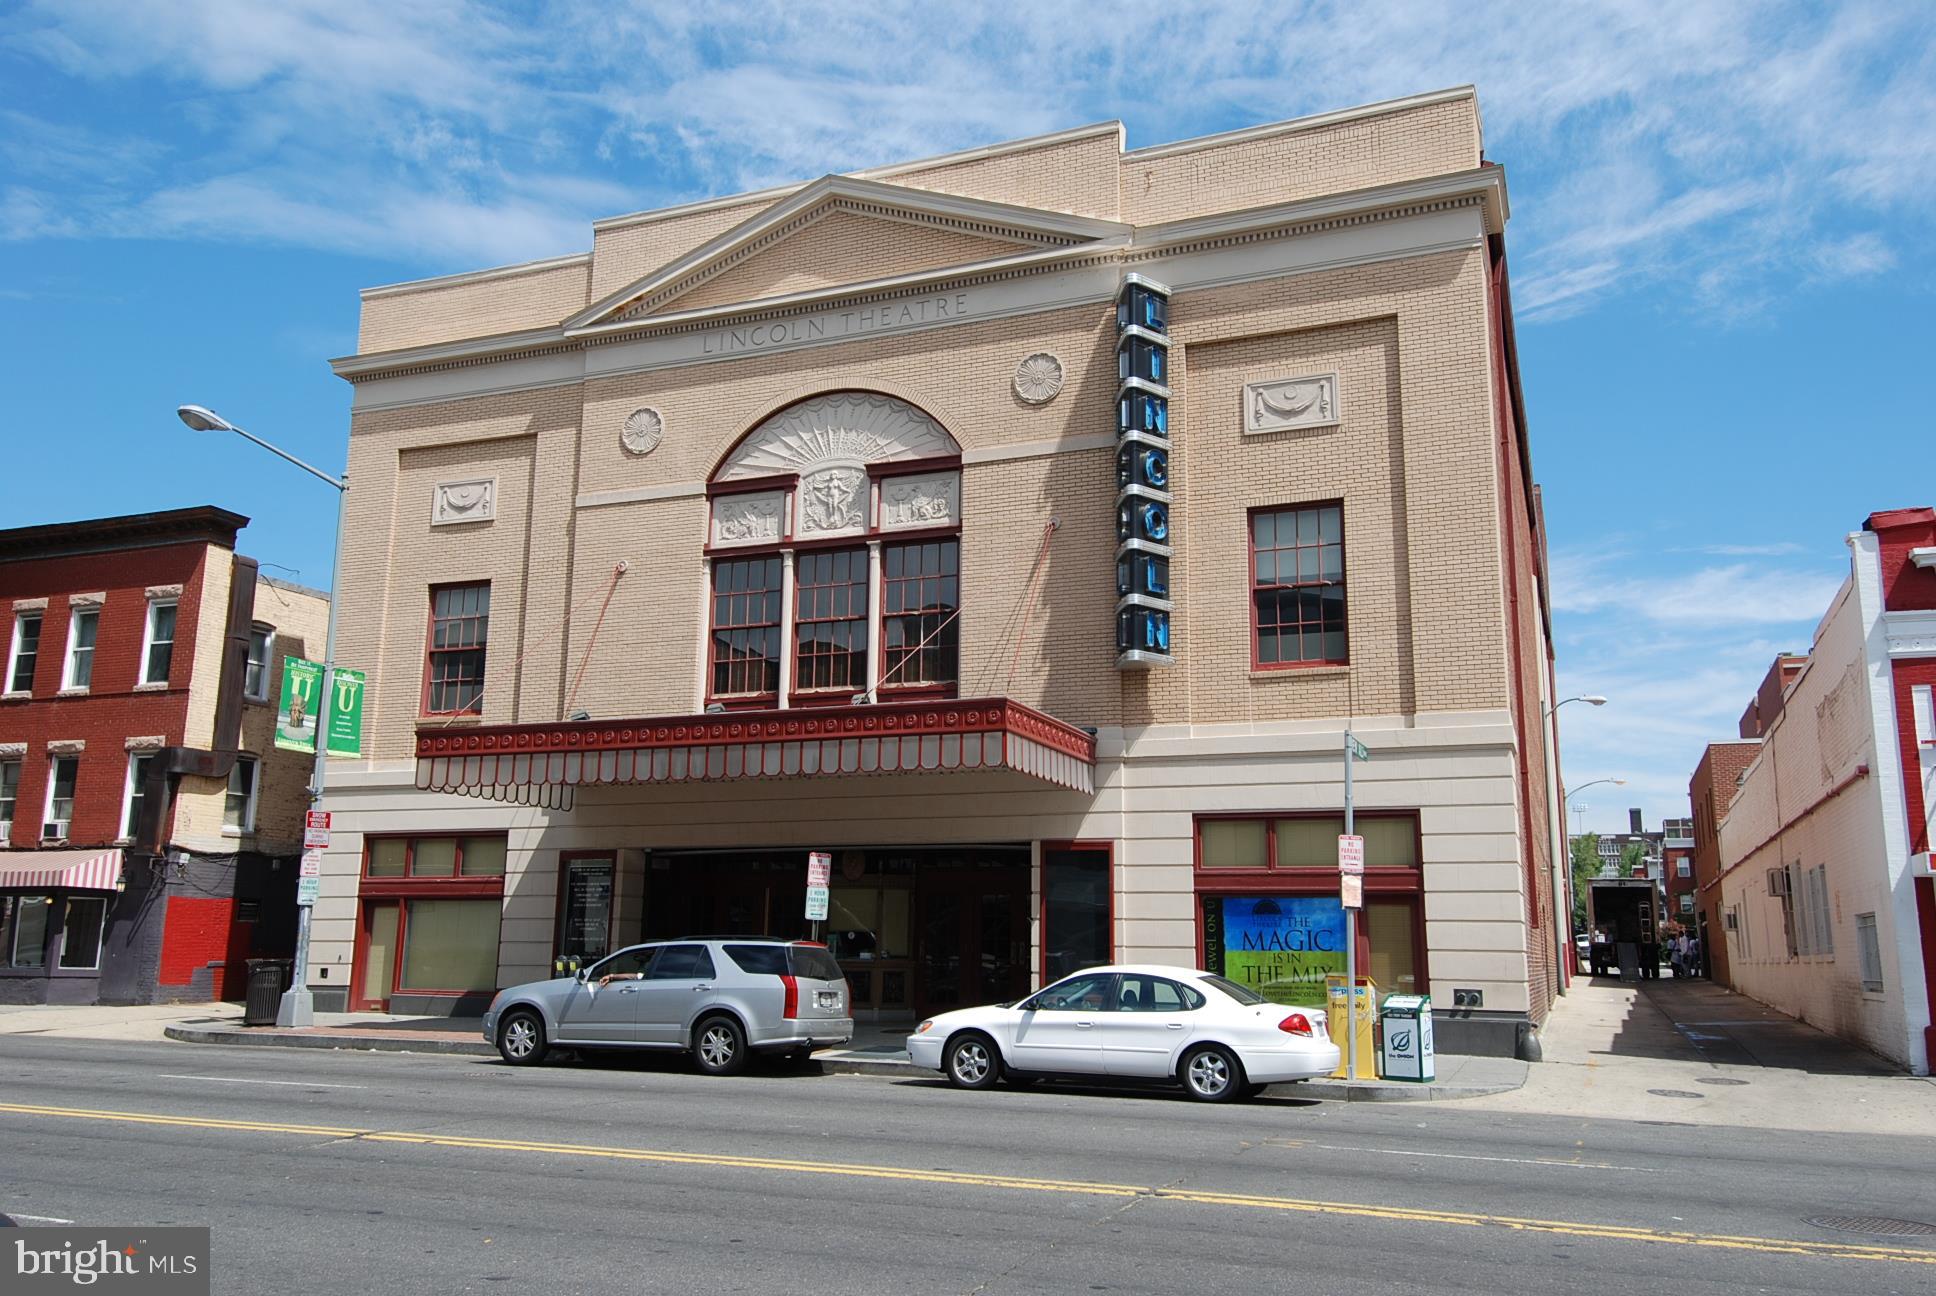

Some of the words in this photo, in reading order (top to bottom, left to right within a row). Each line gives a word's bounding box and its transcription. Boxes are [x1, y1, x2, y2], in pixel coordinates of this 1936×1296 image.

[703, 317, 825, 354] LINCOLN
[841, 294, 968, 332] THEATRE
[1144, 293, 1169, 650] LINCOLN
[338, 686, 357, 712] U
[1287, 917, 1312, 928] THE
[1242, 930, 1333, 952] MAGIC
[1273, 953, 1283, 963] IS
[1287, 953, 1301, 963] IN
[1242, 965, 1284, 984] THE
[1292, 965, 1333, 984] MIX
